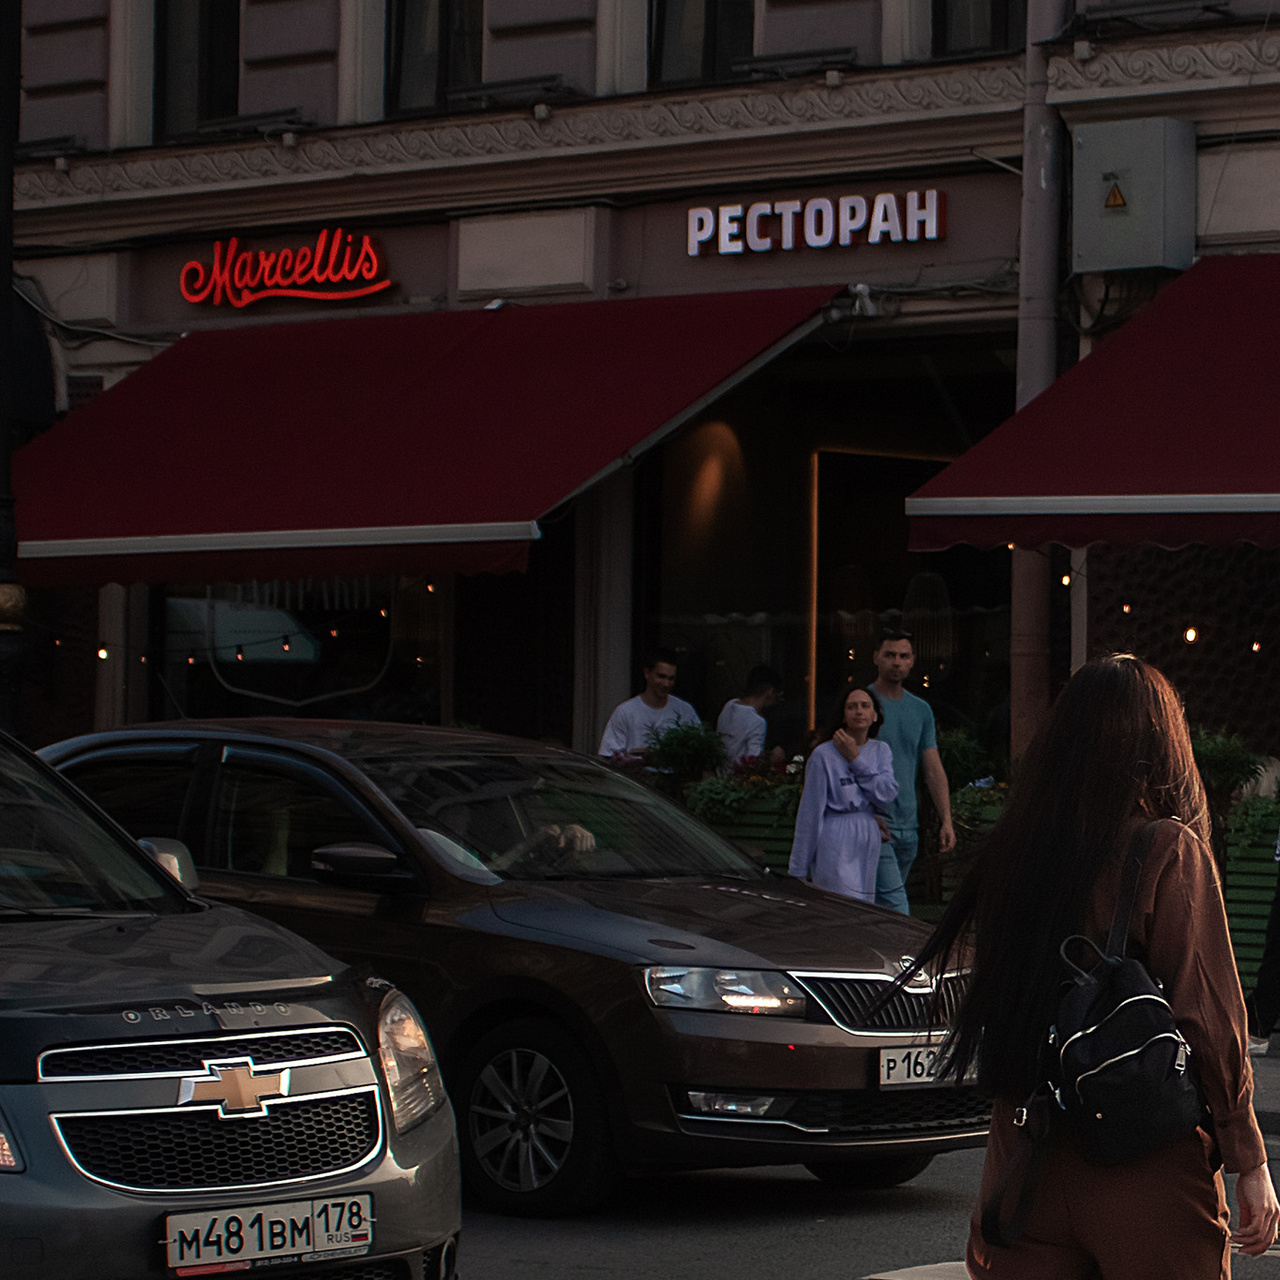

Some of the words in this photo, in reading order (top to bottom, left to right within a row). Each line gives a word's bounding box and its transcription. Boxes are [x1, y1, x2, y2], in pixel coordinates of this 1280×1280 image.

[687, 189, 942, 257] РЕСТОРАН
[179, 227, 392, 309] Marcellis
[121, 1001, 291, 1024] ORLANDO
[316, 1200, 362, 1233] 178
[326, 1231, 351, 1244] RUS
